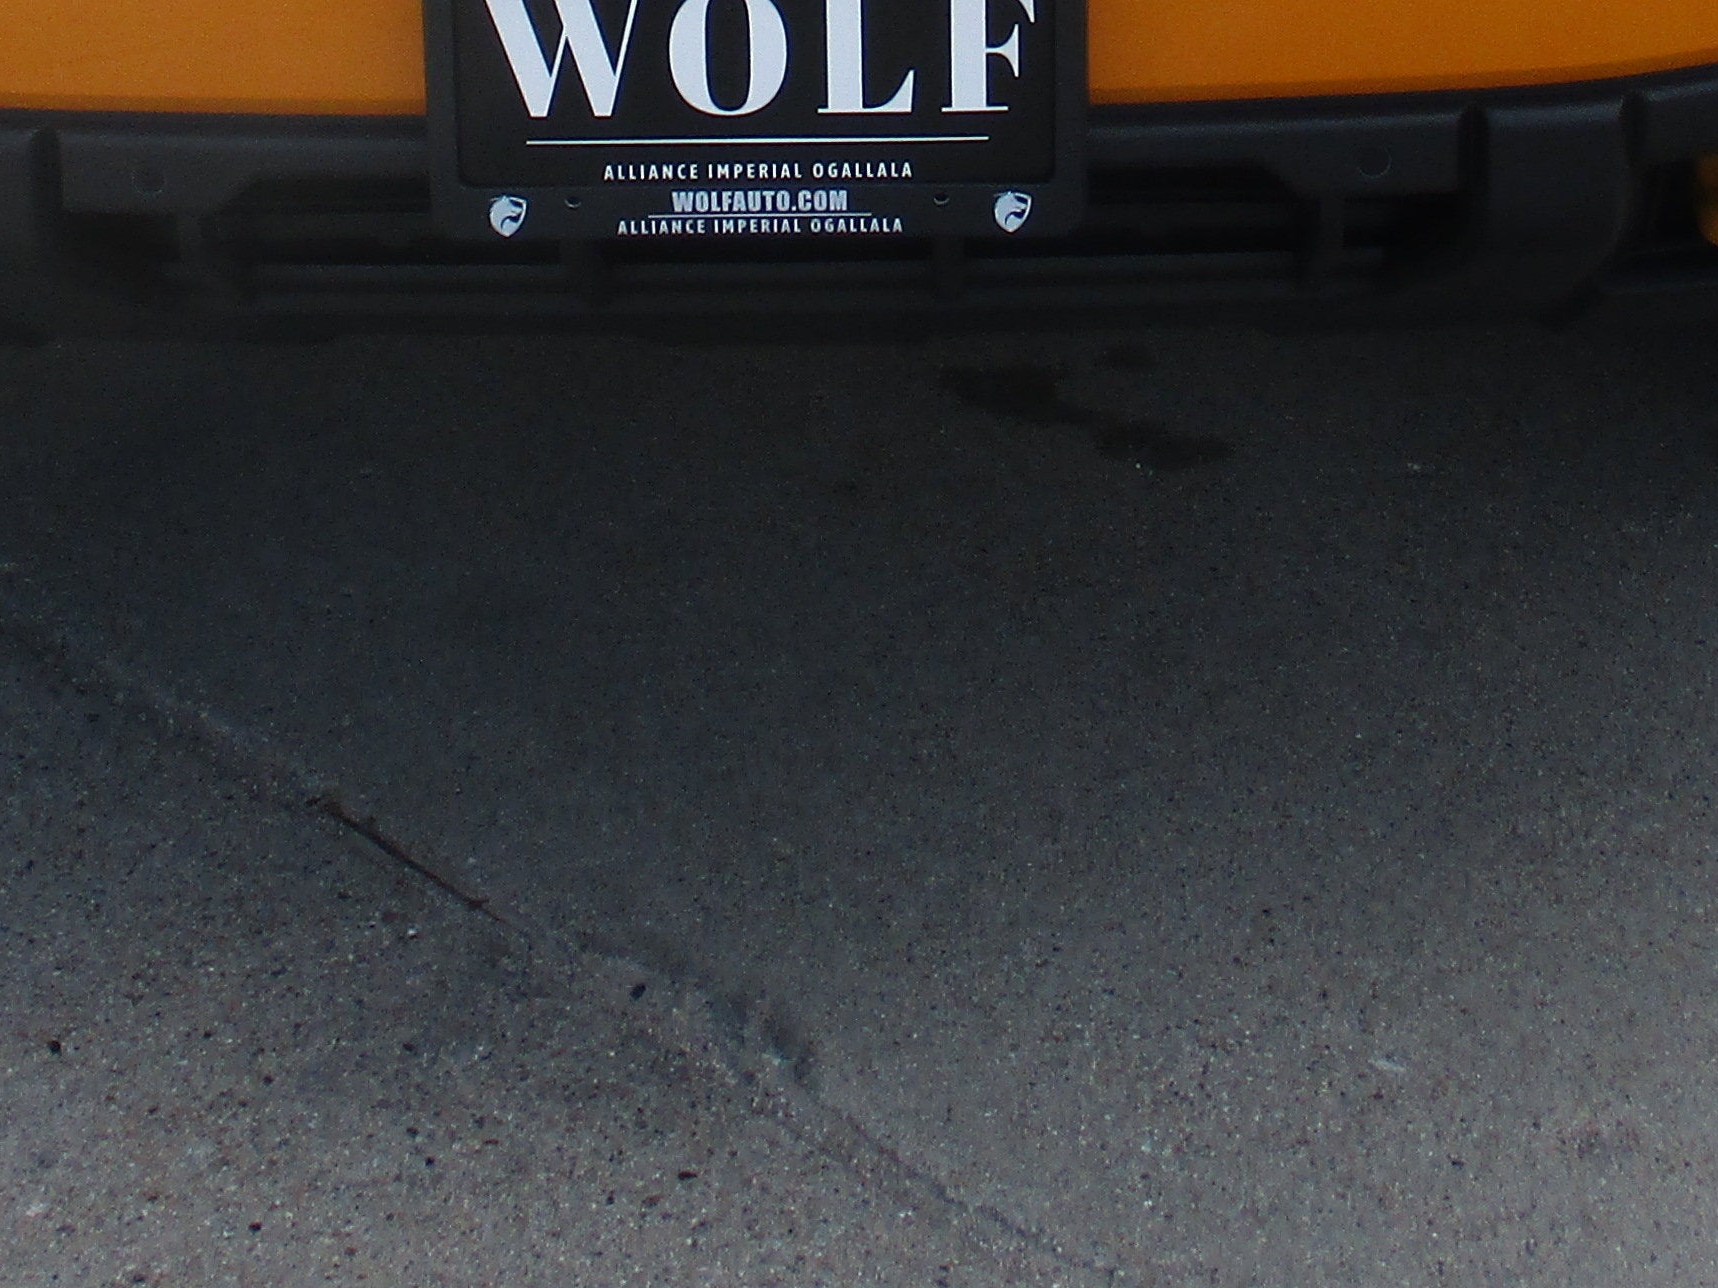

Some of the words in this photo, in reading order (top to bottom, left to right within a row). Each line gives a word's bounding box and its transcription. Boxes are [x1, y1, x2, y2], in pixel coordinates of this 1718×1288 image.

[603, 163, 699, 181] ALLIANCE
[707, 162, 803, 180] IMPERIAL
[811, 161, 913, 179] OGALLALA
[671, 189, 848, 213] WOLFAUTO.COM
[616, 218, 706, 235] ALLIANCE
[713, 218, 801, 234] IMPERIAL
[809, 217, 904, 234] OGALLALA
